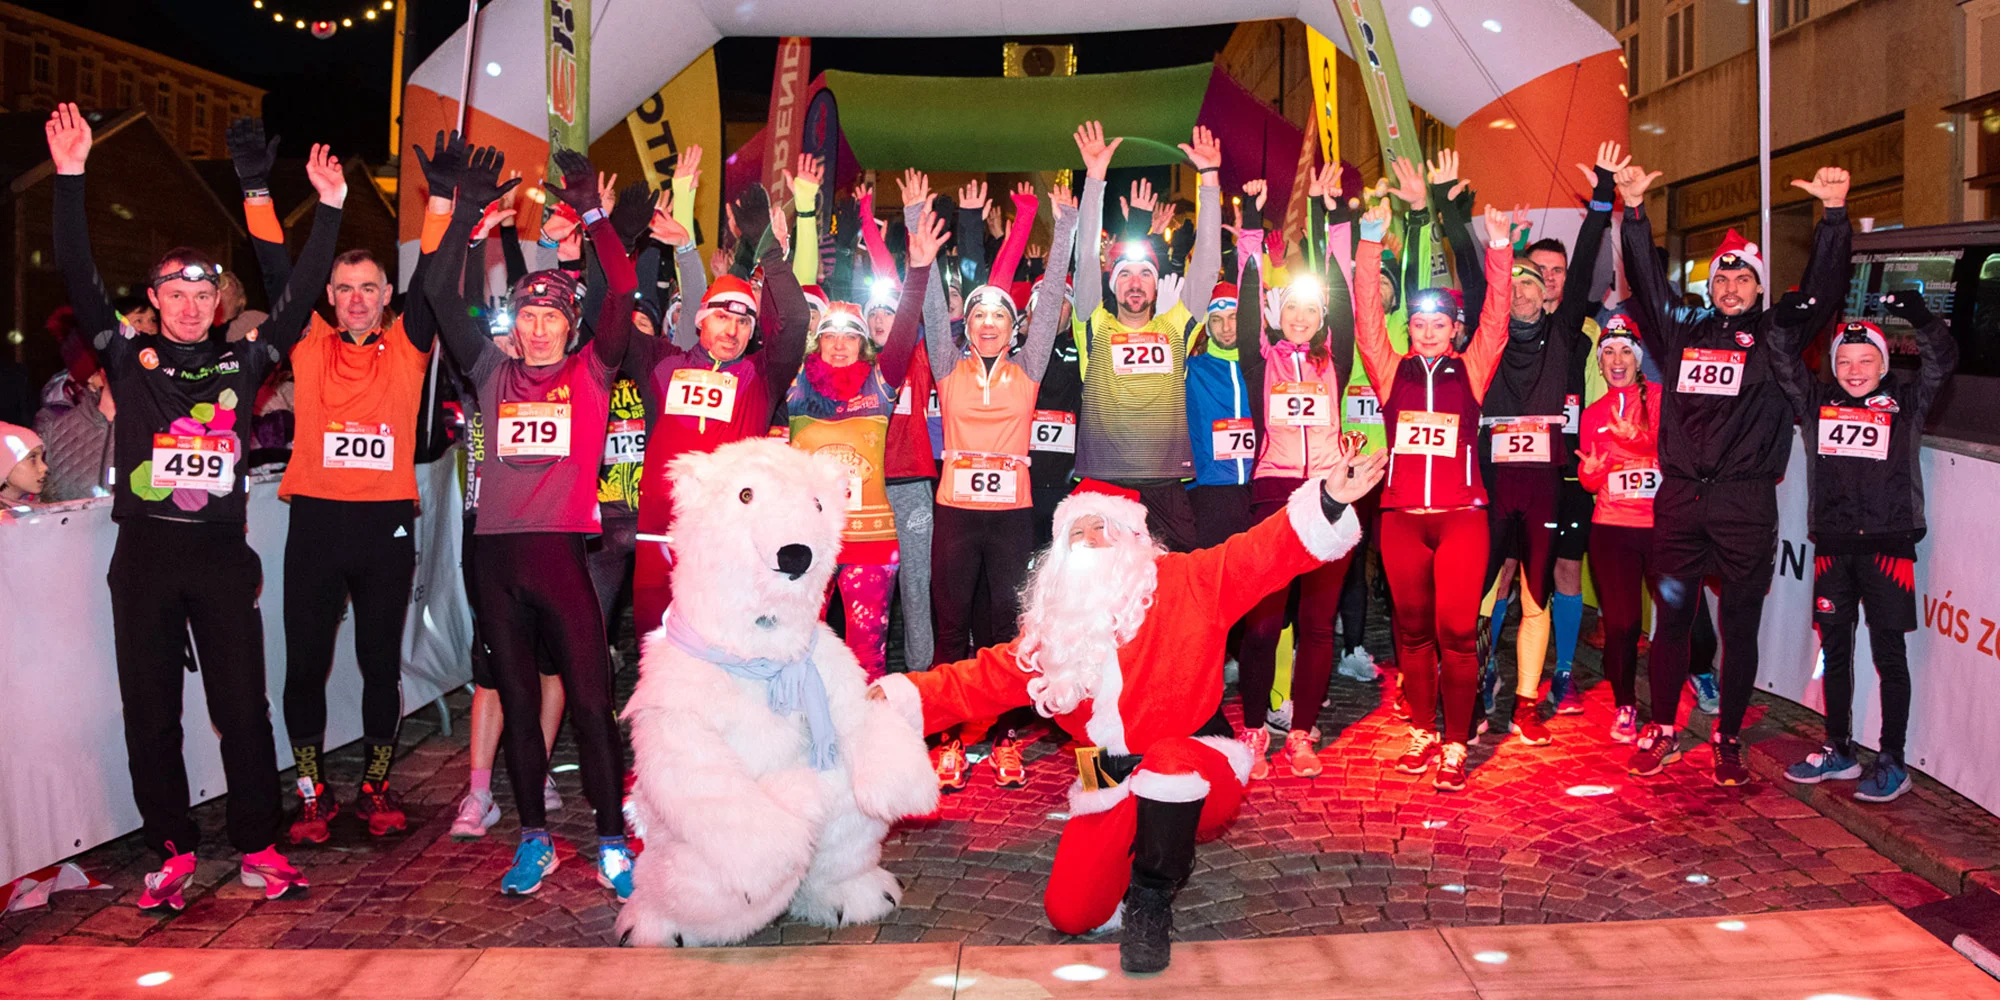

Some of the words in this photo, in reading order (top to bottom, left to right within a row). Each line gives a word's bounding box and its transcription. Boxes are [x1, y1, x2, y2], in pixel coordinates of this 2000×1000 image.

[1122, 346, 1165, 365] 220
[1687, 364, 1735, 385] 480
[681, 384, 723, 409] 159
[1287, 397, 1315, 416] 92
[511, 421, 557, 444] 219
[1037, 424, 1063, 443] 67
[1229, 432, 1255, 452] 76
[1408, 426, 1446, 447] 215
[1828, 424, 1879, 447] 479
[335, 436, 386, 459] 200
[610, 433, 646, 455] 129
[1508, 435, 1534, 453] 52
[164, 453, 225, 479] 499
[971, 472, 1002, 493] 68
[1618, 472, 1656, 490] 193
[1923, 589, 1970, 644] vás
